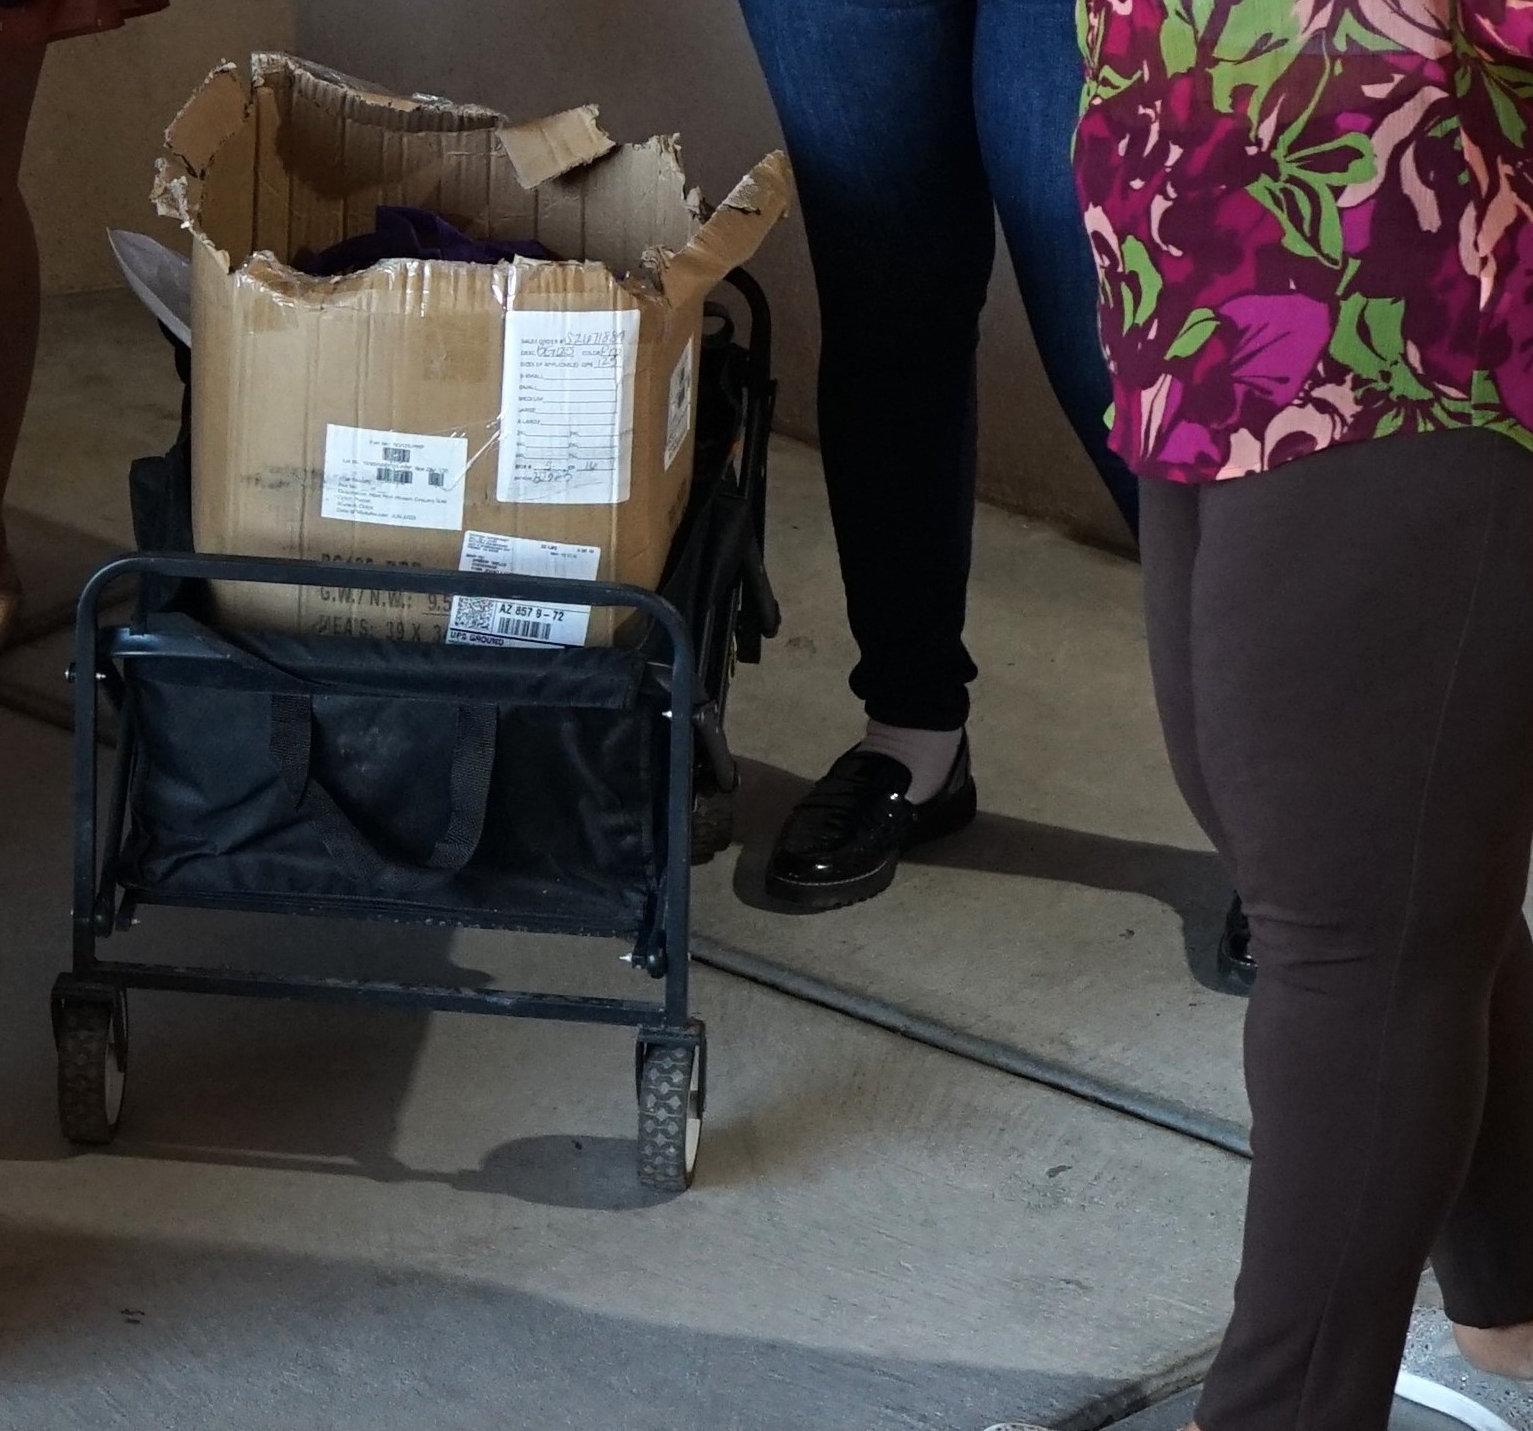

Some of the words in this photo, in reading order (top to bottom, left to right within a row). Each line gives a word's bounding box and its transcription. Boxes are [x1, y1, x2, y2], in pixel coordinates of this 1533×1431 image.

[499, 604, 513, 614] AZ
[412, 622, 422, 642] X
[450, 631, 467, 640] UPS
[469, 633, 505, 646] GROUND
